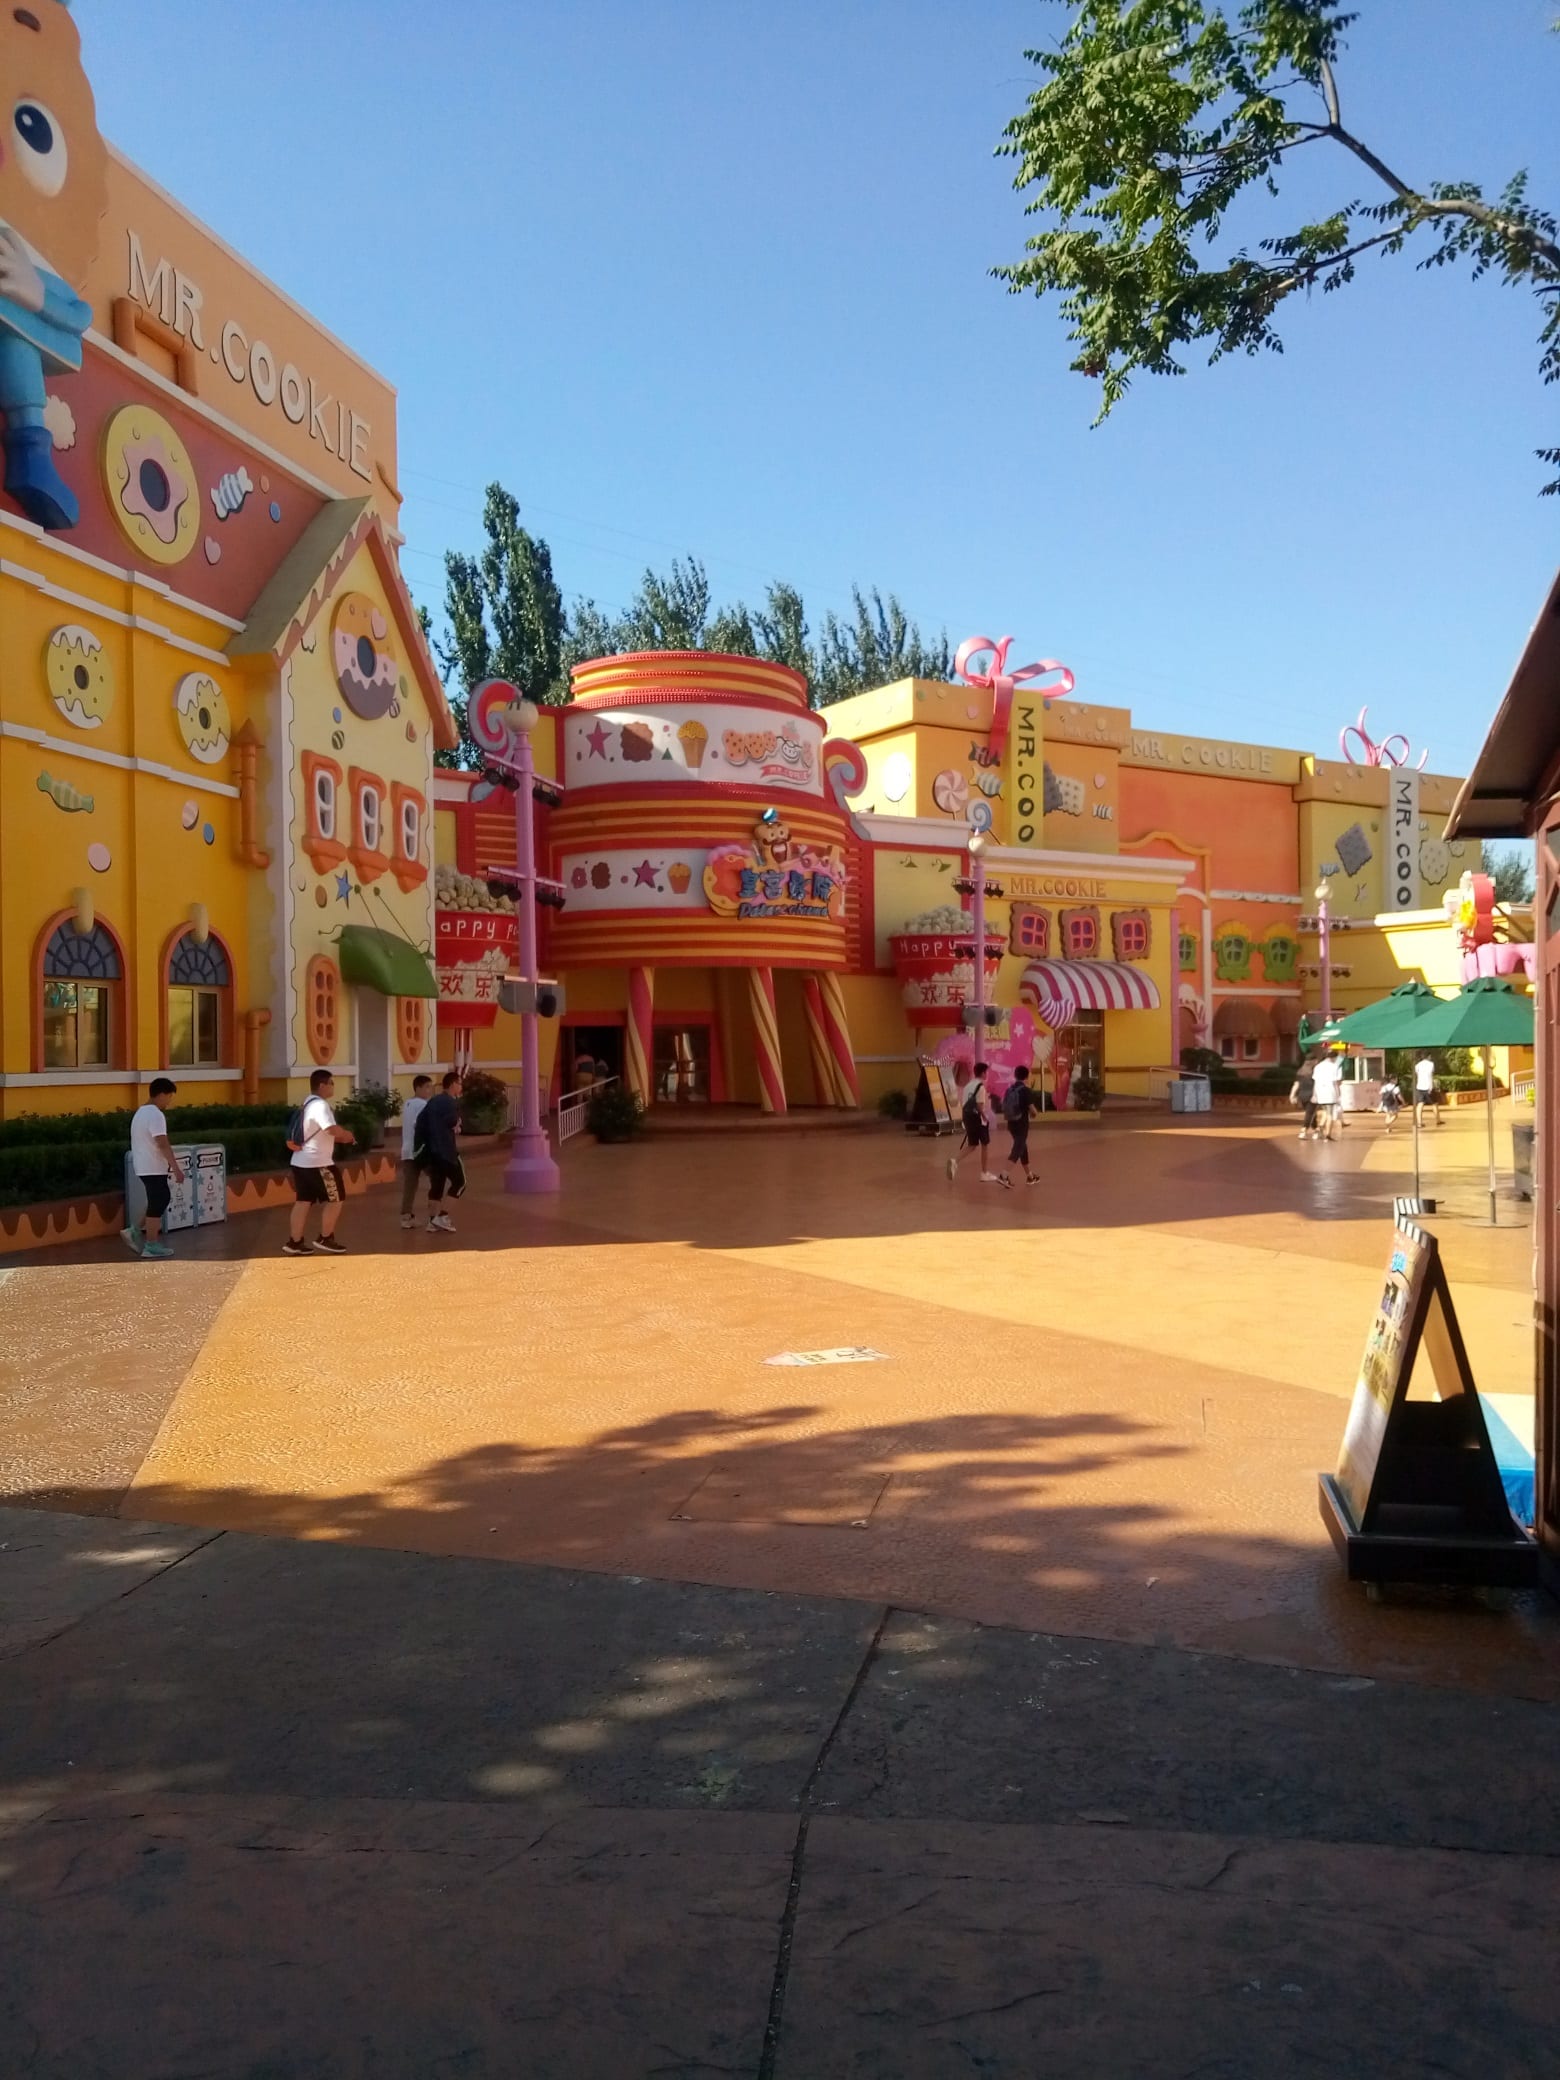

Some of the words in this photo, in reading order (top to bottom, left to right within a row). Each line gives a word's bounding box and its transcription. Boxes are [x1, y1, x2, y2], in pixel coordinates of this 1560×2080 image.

[1018, 706, 1035, 843] MR.COO
[1396, 780, 1412, 906] MR.COO
[440, 919, 496, 940] appy
[440, 975, 493, 999] 欢乐
[920, 985, 966, 1005] 欢乐
